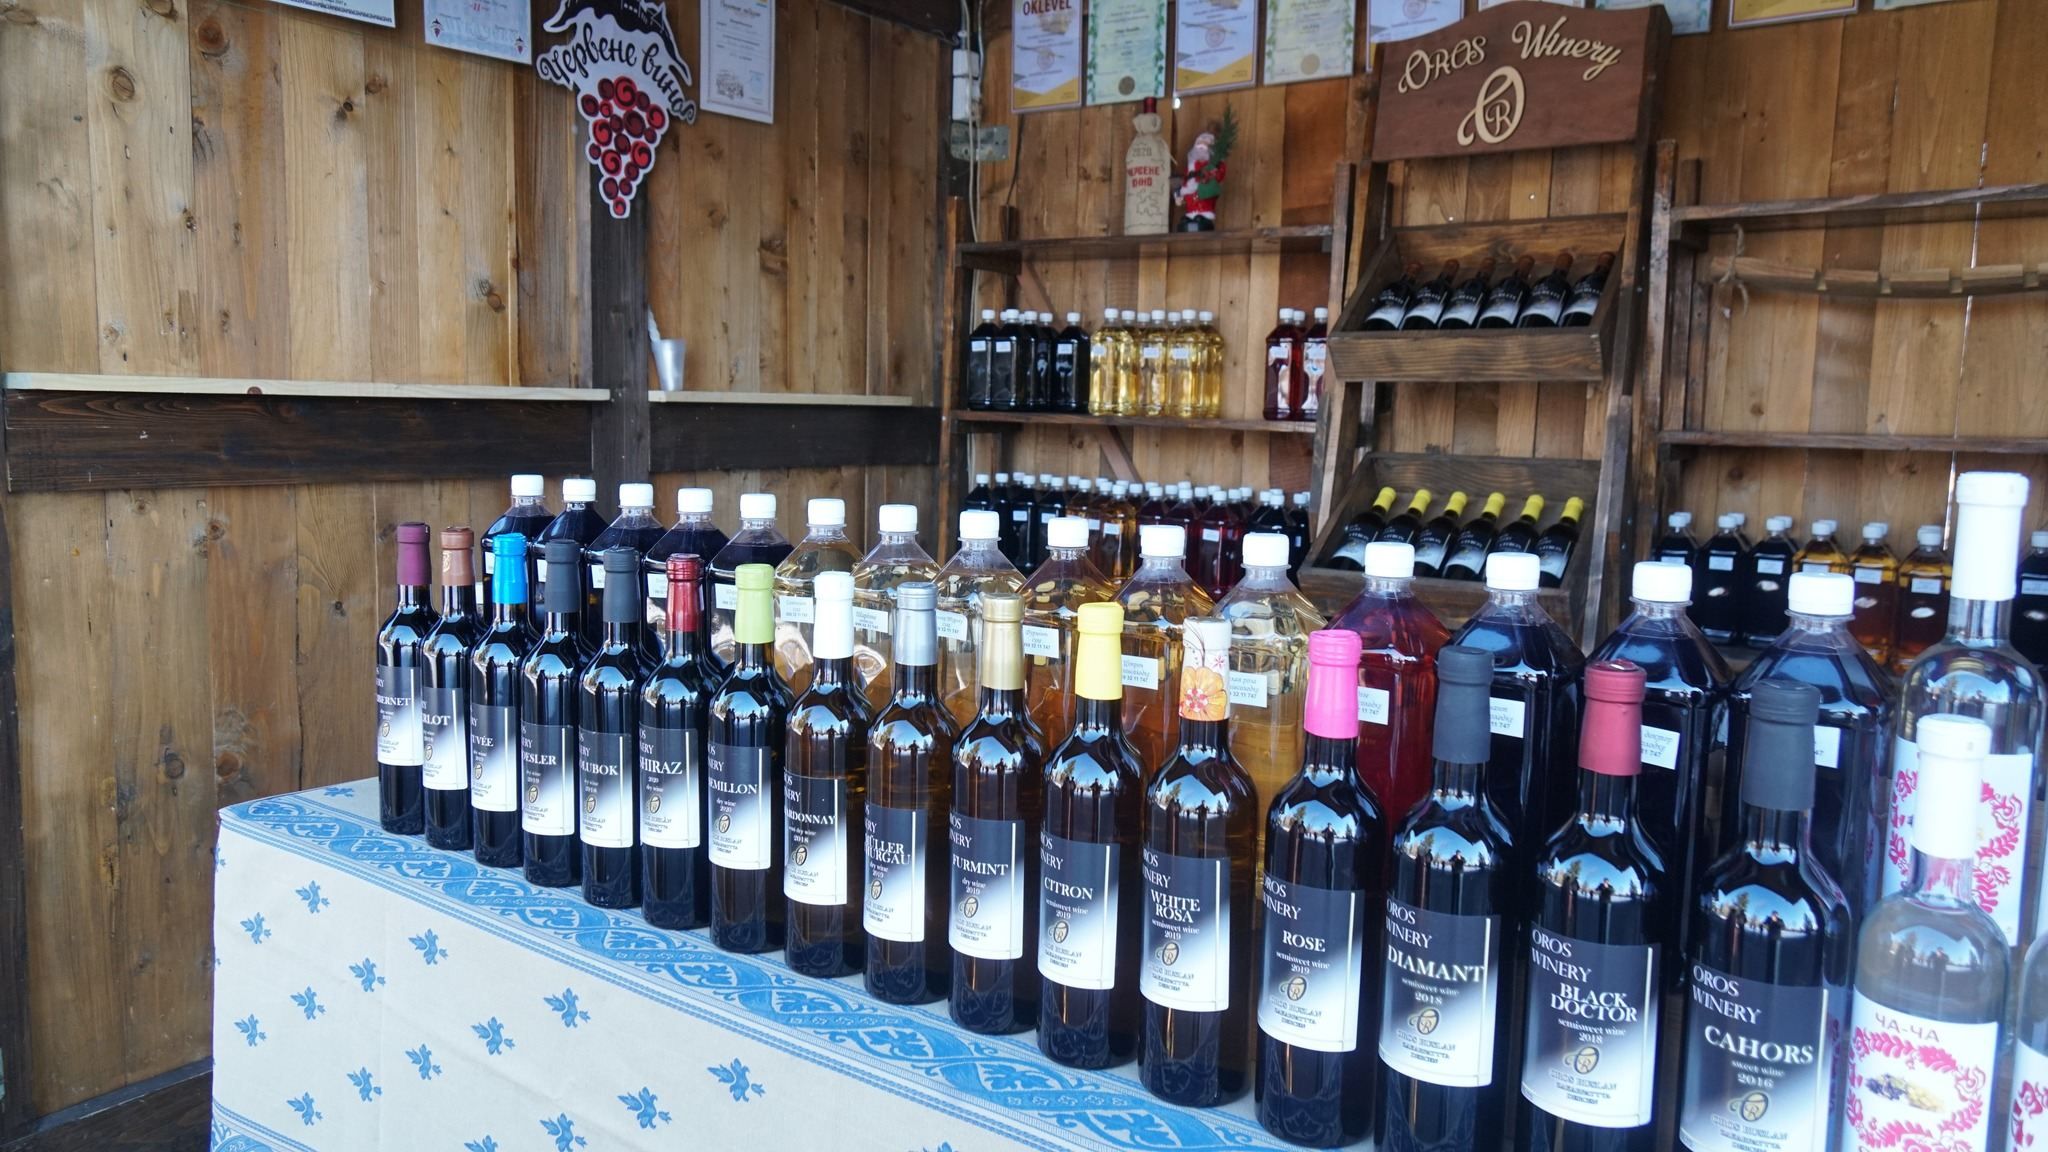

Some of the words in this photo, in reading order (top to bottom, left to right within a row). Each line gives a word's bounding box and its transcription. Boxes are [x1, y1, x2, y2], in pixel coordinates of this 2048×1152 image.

[1512, 16, 1621, 81] Winery
[377, 695, 411, 705] BERNET
[423, 713, 451, 725] RLOT
[472, 735, 494, 746] UVÉE
[953, 853, 1008, 876] FURMINT
[962, 877, 971, 889] dry
[972, 880, 986, 889] wine
[1044, 876, 1093, 900] CITRON
[1072, 905, 1089, 914] wine
[1151, 889, 1201, 912] WHITE
[1056, 910, 1071, 920] 2019
[1155, 906, 1194, 923] ROSA
[1386, 898, 1416, 925] OROS
[1165, 931, 1181, 940] 2019
[1183, 926, 1200, 935] wine
[1386, 915, 1432, 949] WINERY
[1282, 930, 1326, 952] ROSE
[1532, 929, 1572, 958] OROS
[1276, 951, 1311, 967] semisweet
[1312, 959, 1330, 970] wine
[1291, 964, 1310, 975] 2019
[1388, 944, 1484, 982] DIAMANT
[1531, 947, 1592, 983] WINERY
[1693, 965, 1740, 997] OROS
[1415, 992, 1443, 1005] 2018
[1439, 986, 1459, 996] wine
[1560, 983, 1627, 1008] BLACK
[1551, 993, 1638, 1022] DOCTOR
[1692, 984, 1762, 1025] WINERY
[1558, 1018, 1604, 1035] semisweet
[1605, 1026, 1626, 1037] wine
[1875, 1012, 1940, 1043] ЧА-ЧА
[1579, 1032, 1603, 1044] 2018
[1704, 1025, 1813, 1064] CAHORS
[1732, 1060, 1760, 1074] sweet
[1761, 1067, 1785, 1077] wine
[1738, 1073, 1774, 1088] 2016
